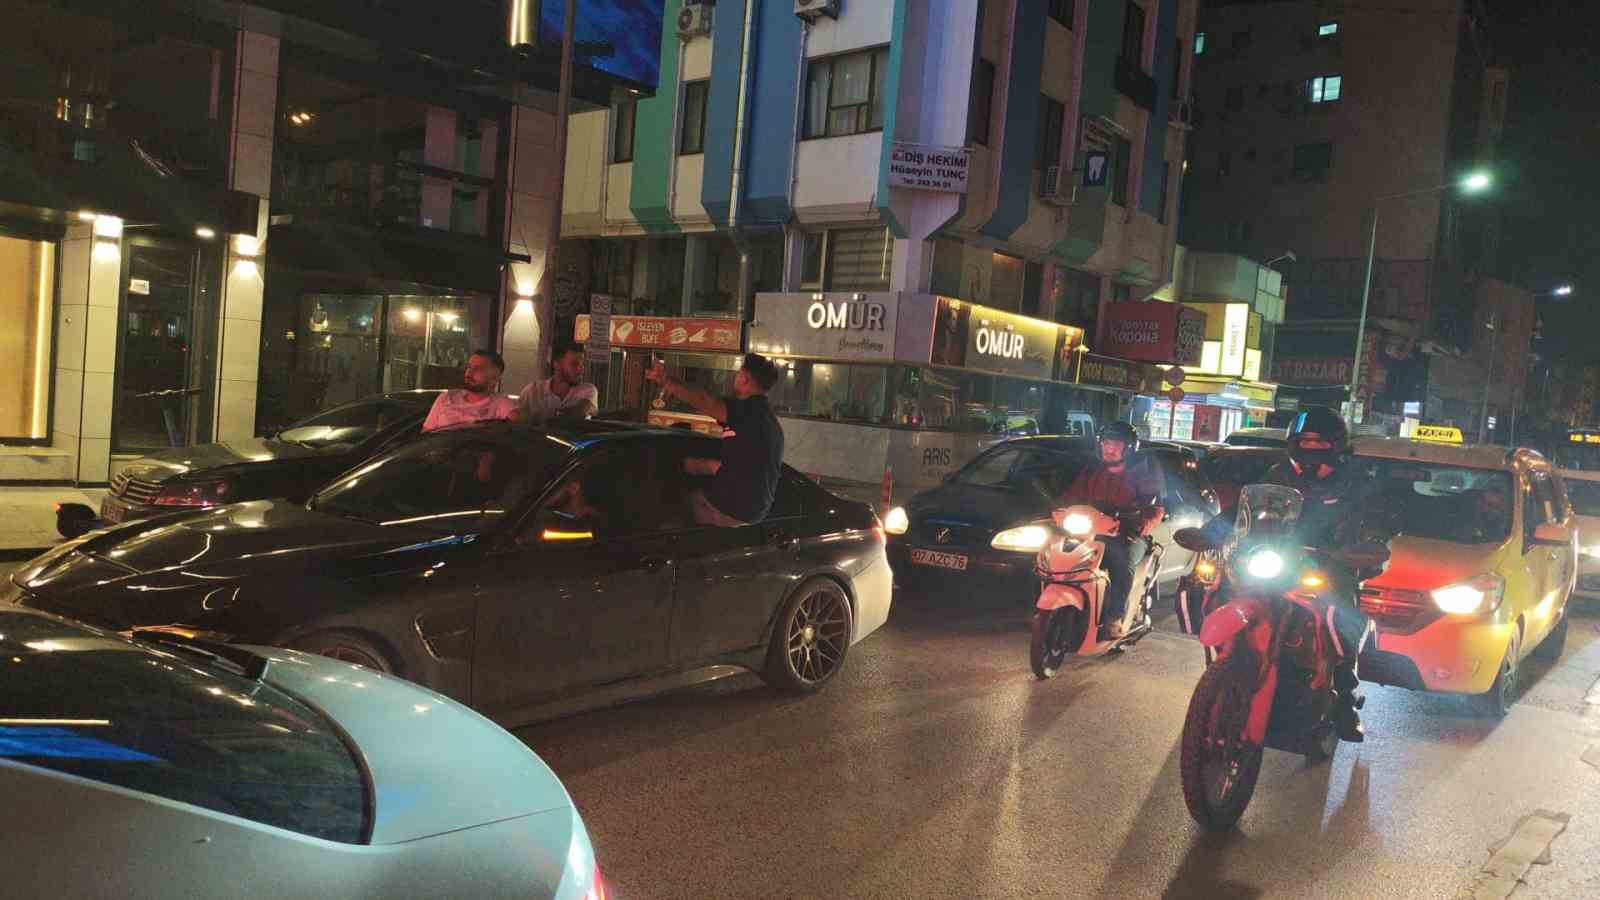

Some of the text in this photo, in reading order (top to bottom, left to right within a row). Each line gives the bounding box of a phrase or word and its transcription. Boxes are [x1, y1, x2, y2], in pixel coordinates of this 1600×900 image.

[890, 164, 933, 177] Hüseyin
[927, 154, 967, 168] HEKİMİ
[807, 293, 885, 329] ÖMÜR
[976, 319, 1025, 359] ÖMÜR
